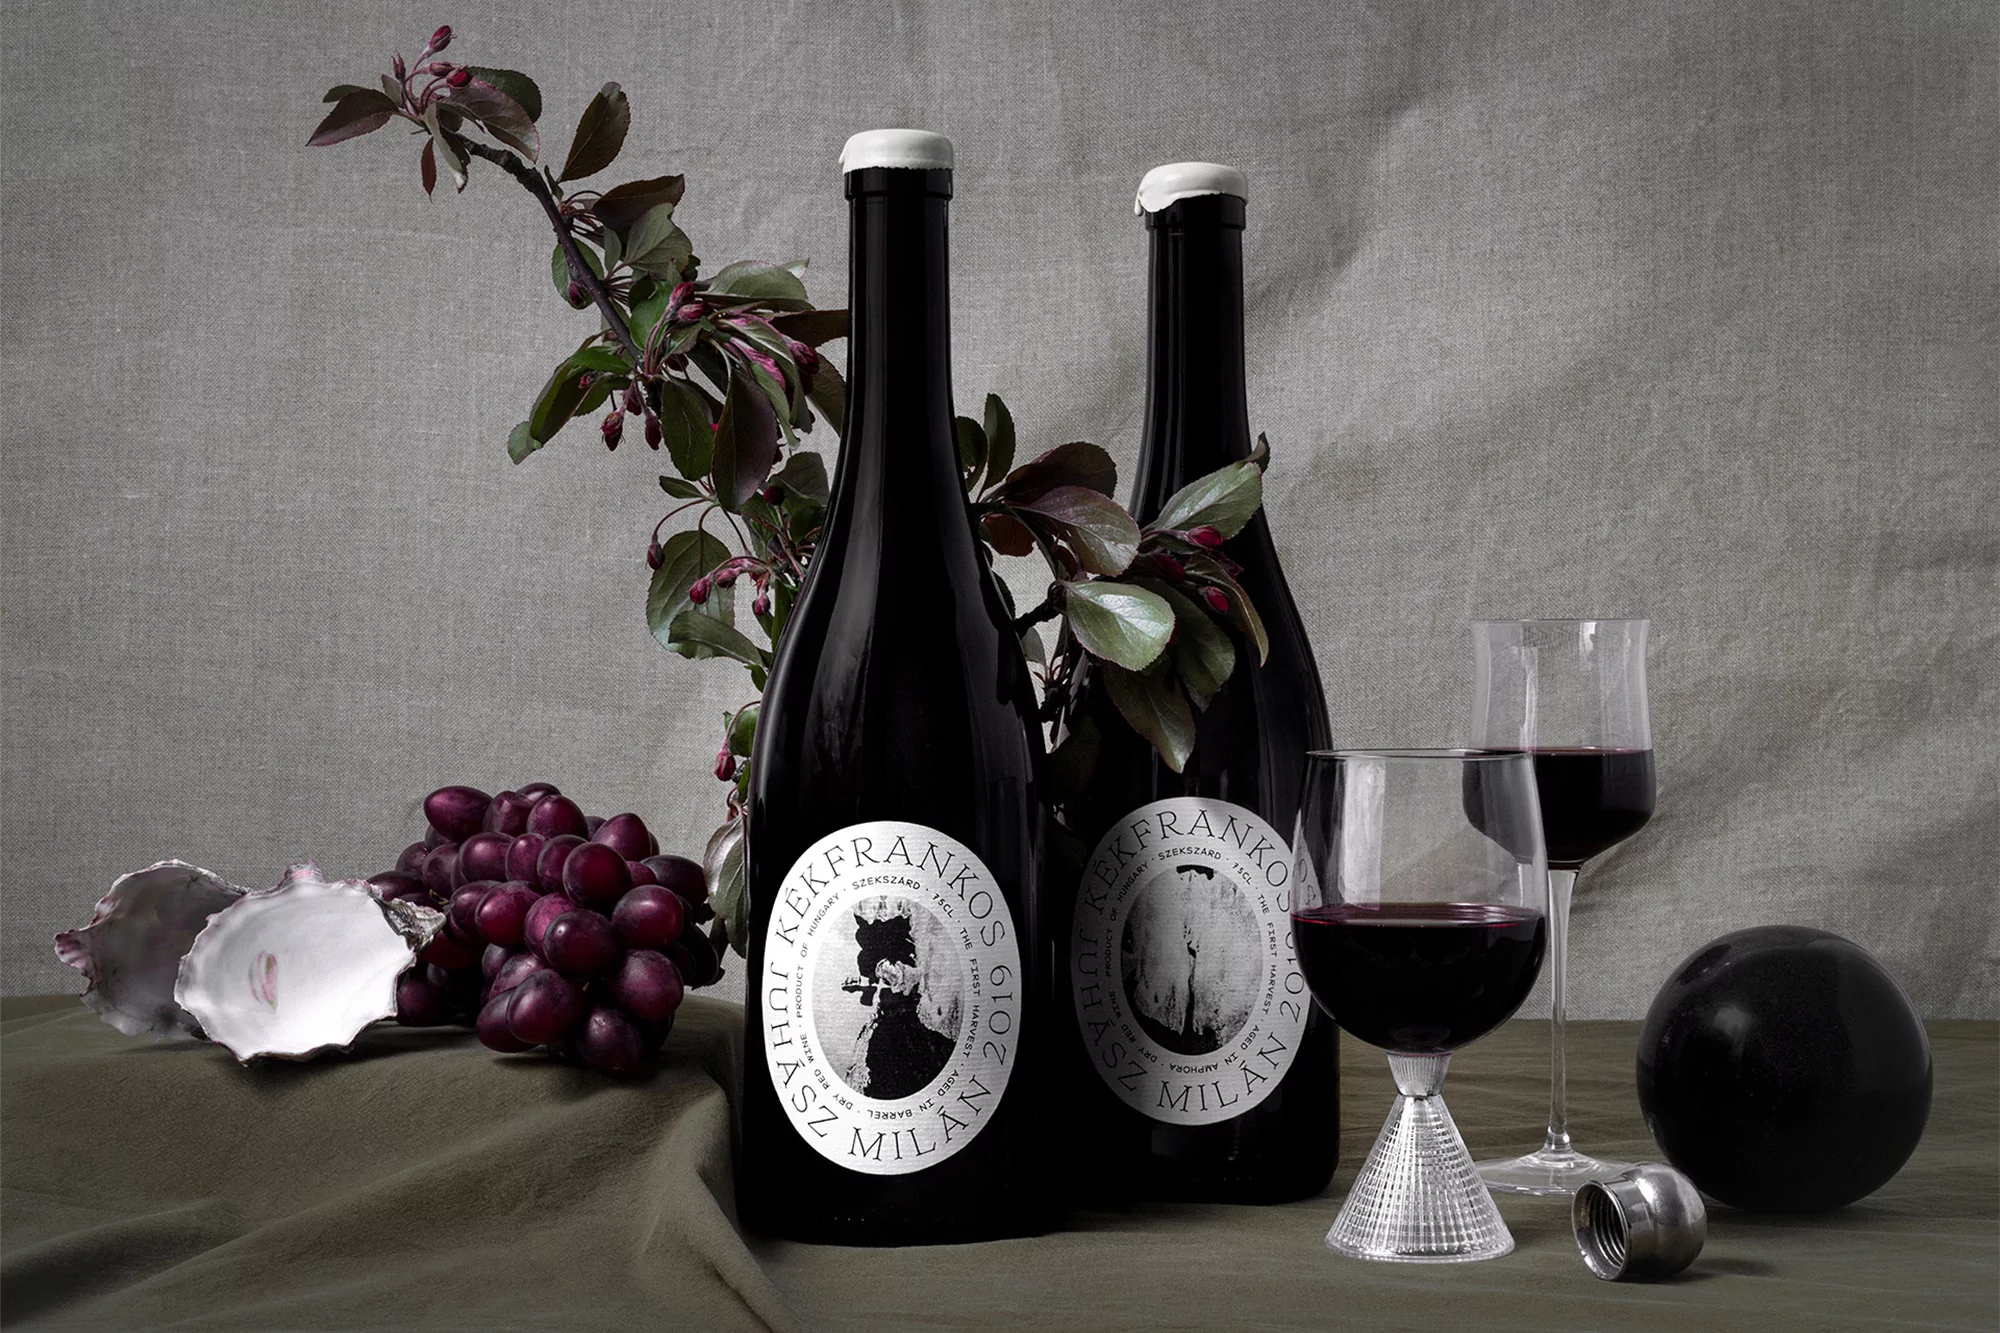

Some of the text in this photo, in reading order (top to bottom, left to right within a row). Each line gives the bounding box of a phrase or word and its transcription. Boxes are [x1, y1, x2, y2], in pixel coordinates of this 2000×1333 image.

[1117, 862, 1149, 903] HUNGARY
[1232, 863, 1251, 885] 75CL
[775, 835, 1005, 948] KÉKFRANKOS
[807, 893, 840, 936] HUNGARY
[932, 894, 954, 917] 75CL
[1110, 907, 1118, 921] OF
[1257, 894, 1269, 914] THE
[959, 927, 973, 949] THE
[1267, 923, 1277, 957] FIRST
[800, 942, 808, 958] OF
[970, 958, 980, 996] FIRST
[796, 965, 804, 1018] PRODUCT
[1262, 965, 1276, 1014] HARVEST
[1108, 991, 1122, 1019] WINE
[963, 1004, 979, 1059] HARVEST
[1078, 928, 1148, 1092] JUHÁSZ
[1158, 1032, 1288, 1112] MILÁN
[1121, 1024, 1137, 1044] RED
[1240, 1026, 1259, 1050] AGED
[800, 1034, 814, 1062] WINE
[1139, 1047, 1157, 1063] DRY
[1225, 1052, 1238, 1065] IN
[768, 961, 1013, 1161] JUHÁSZ MILÁN 2019
[1169, 1063, 1219, 1074] AMPHORA
[814, 1069, 830, 1090] RED
[938, 1069, 958, 1096] AGED
[833, 1094, 852, 1110] DRY
[919, 1099, 935, 1112] IN
[867, 1108, 912, 1120] BARREL
